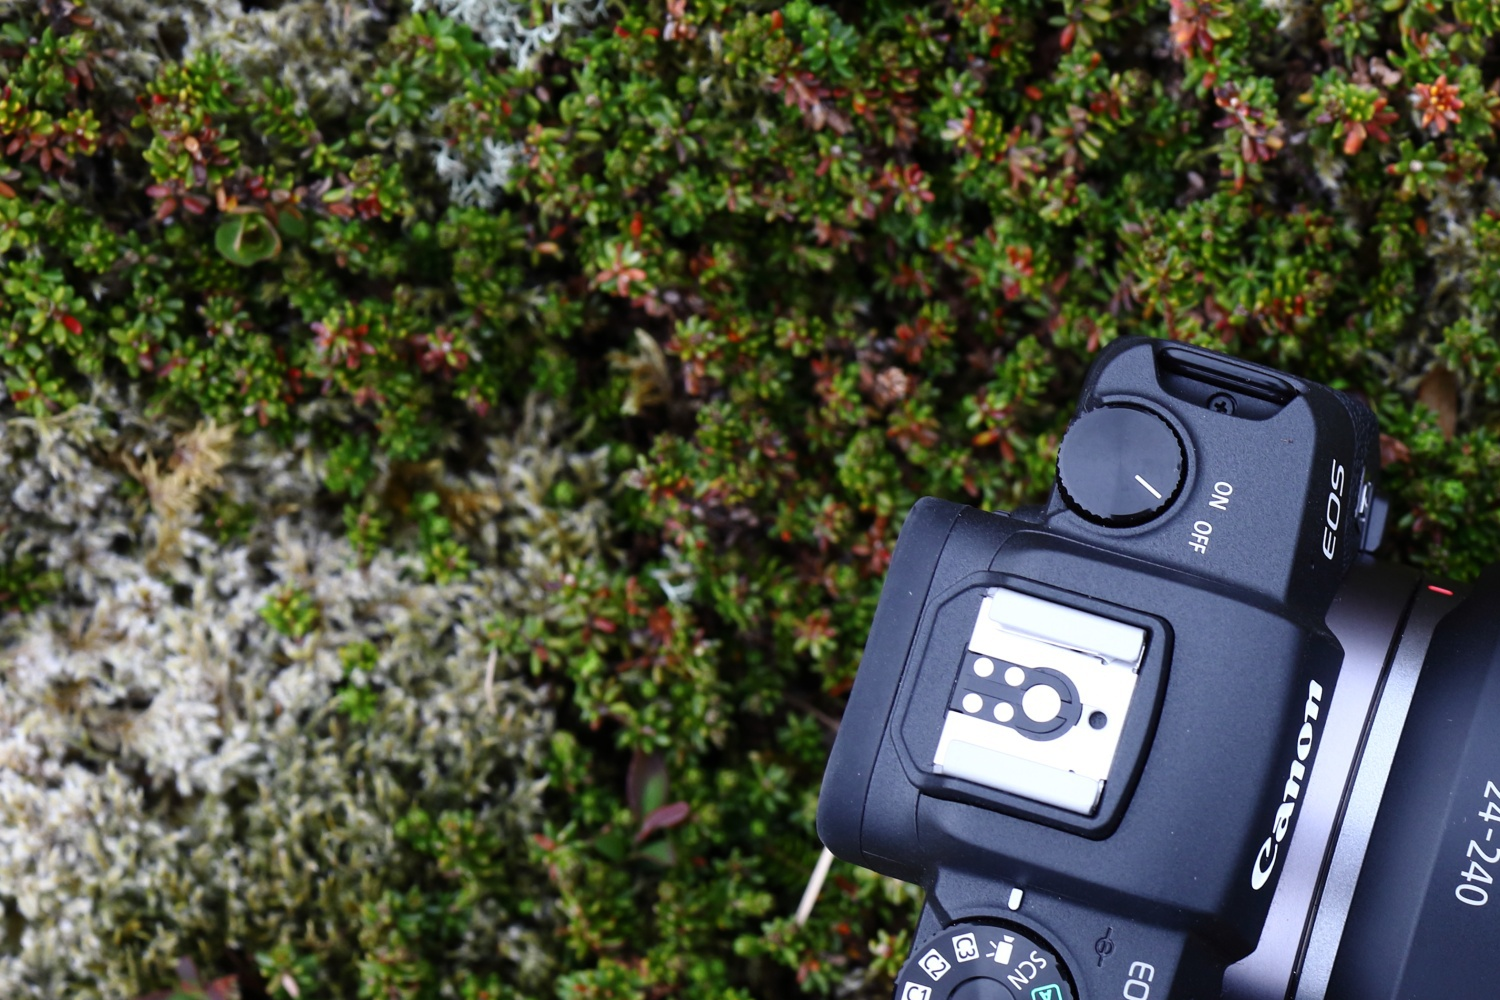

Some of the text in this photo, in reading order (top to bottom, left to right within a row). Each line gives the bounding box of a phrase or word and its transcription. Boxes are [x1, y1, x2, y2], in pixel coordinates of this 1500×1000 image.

[1208, 481, 1233, 511] ON
[1323, 459, 1345, 560] EOS
[1188, 520, 1213, 555] OFF
[1251, 679, 1323, 890] Canon
[920, 950, 949, 979] C2
[953, 934, 978, 961] C3
[1007, 950, 1047, 990] SCN
